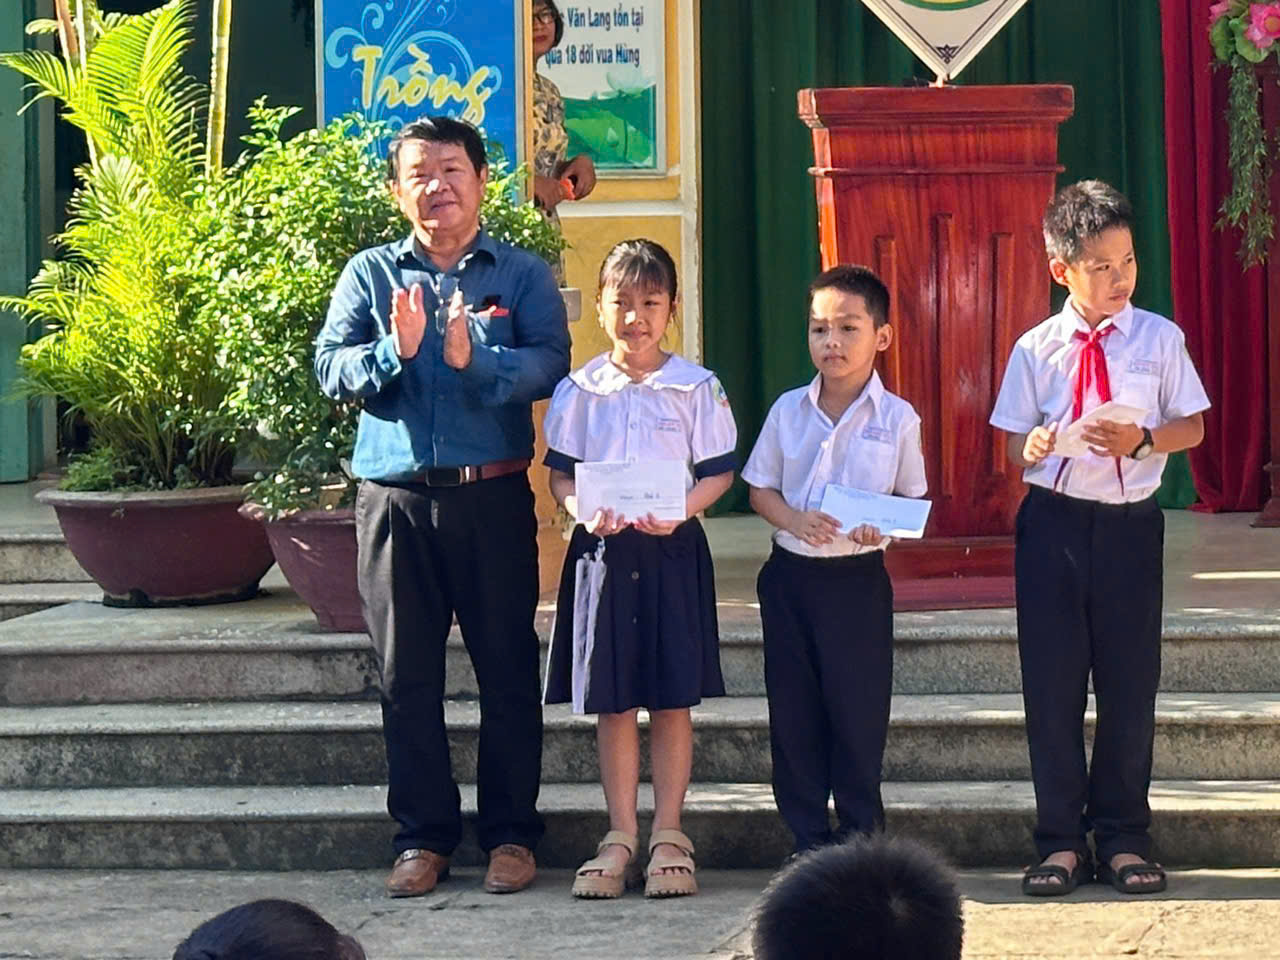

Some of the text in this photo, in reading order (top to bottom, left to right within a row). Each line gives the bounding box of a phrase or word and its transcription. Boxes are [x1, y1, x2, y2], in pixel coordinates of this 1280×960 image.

[567, 7, 585, 27] Văn
[588, 7, 611, 31] Lang
[632, 5, 644, 33] tại
[566, 44, 577, 64] 18
[596, 48, 613, 64] vua
[616, 42, 640, 68] Hùng
[353, 43, 492, 128] Trồng
